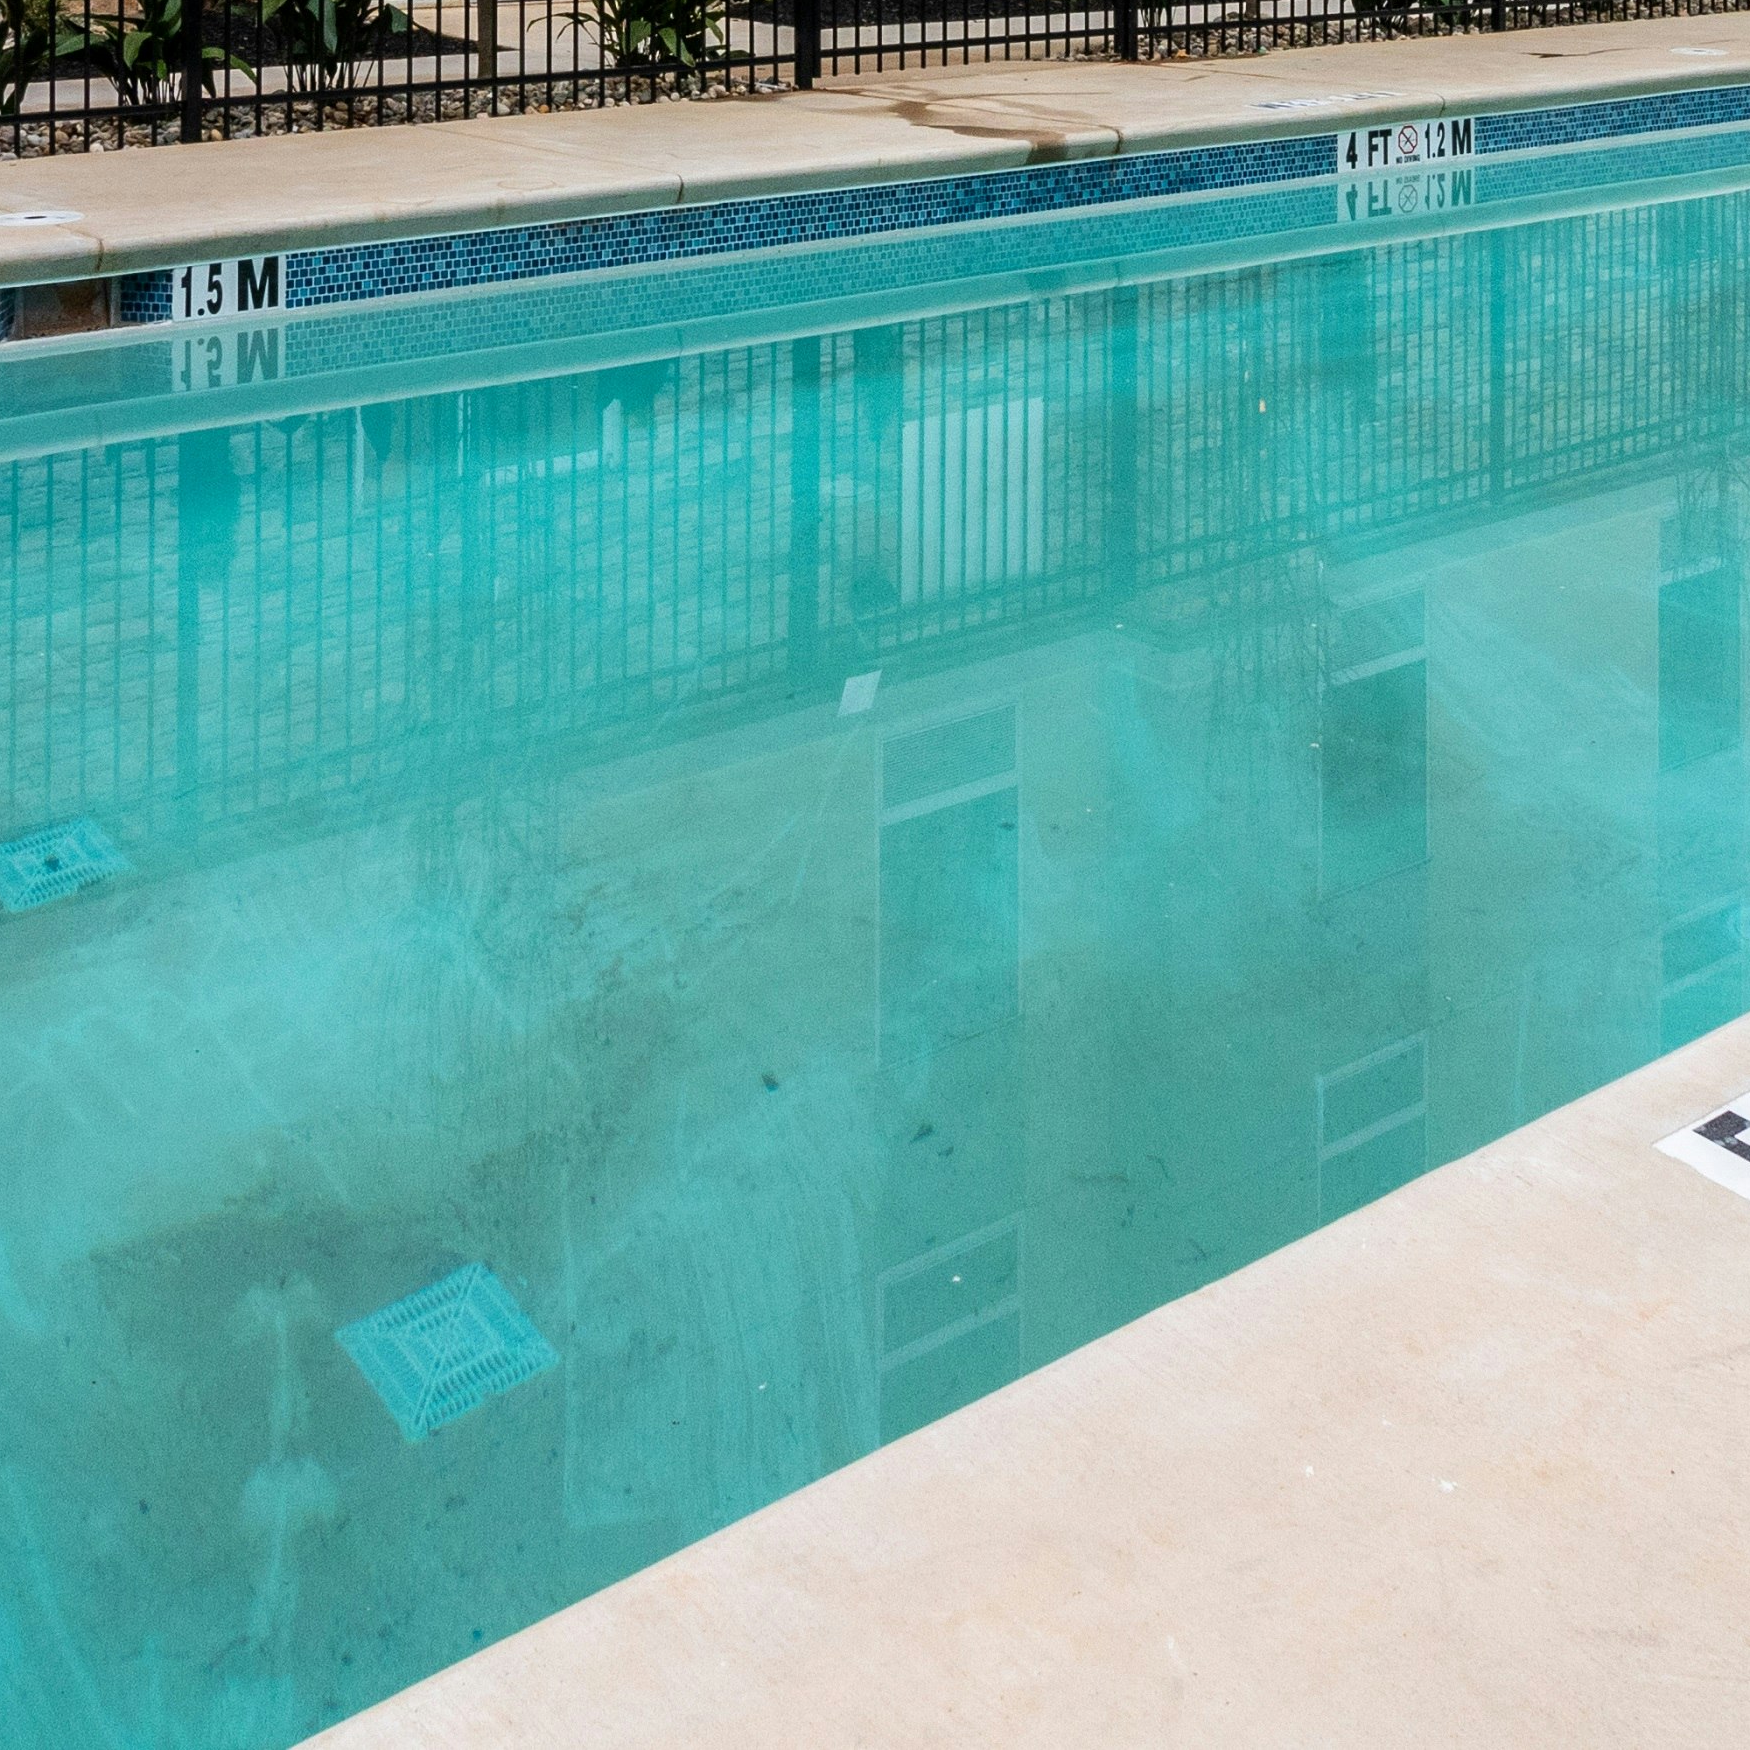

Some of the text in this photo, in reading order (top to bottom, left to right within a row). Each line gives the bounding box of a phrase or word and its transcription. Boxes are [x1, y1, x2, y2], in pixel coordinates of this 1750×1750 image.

[1346, 128, 1392, 169] 4 FT
[1425, 118, 1472, 159] 1.2 M
[181, 256, 279, 318] 1.5 M
